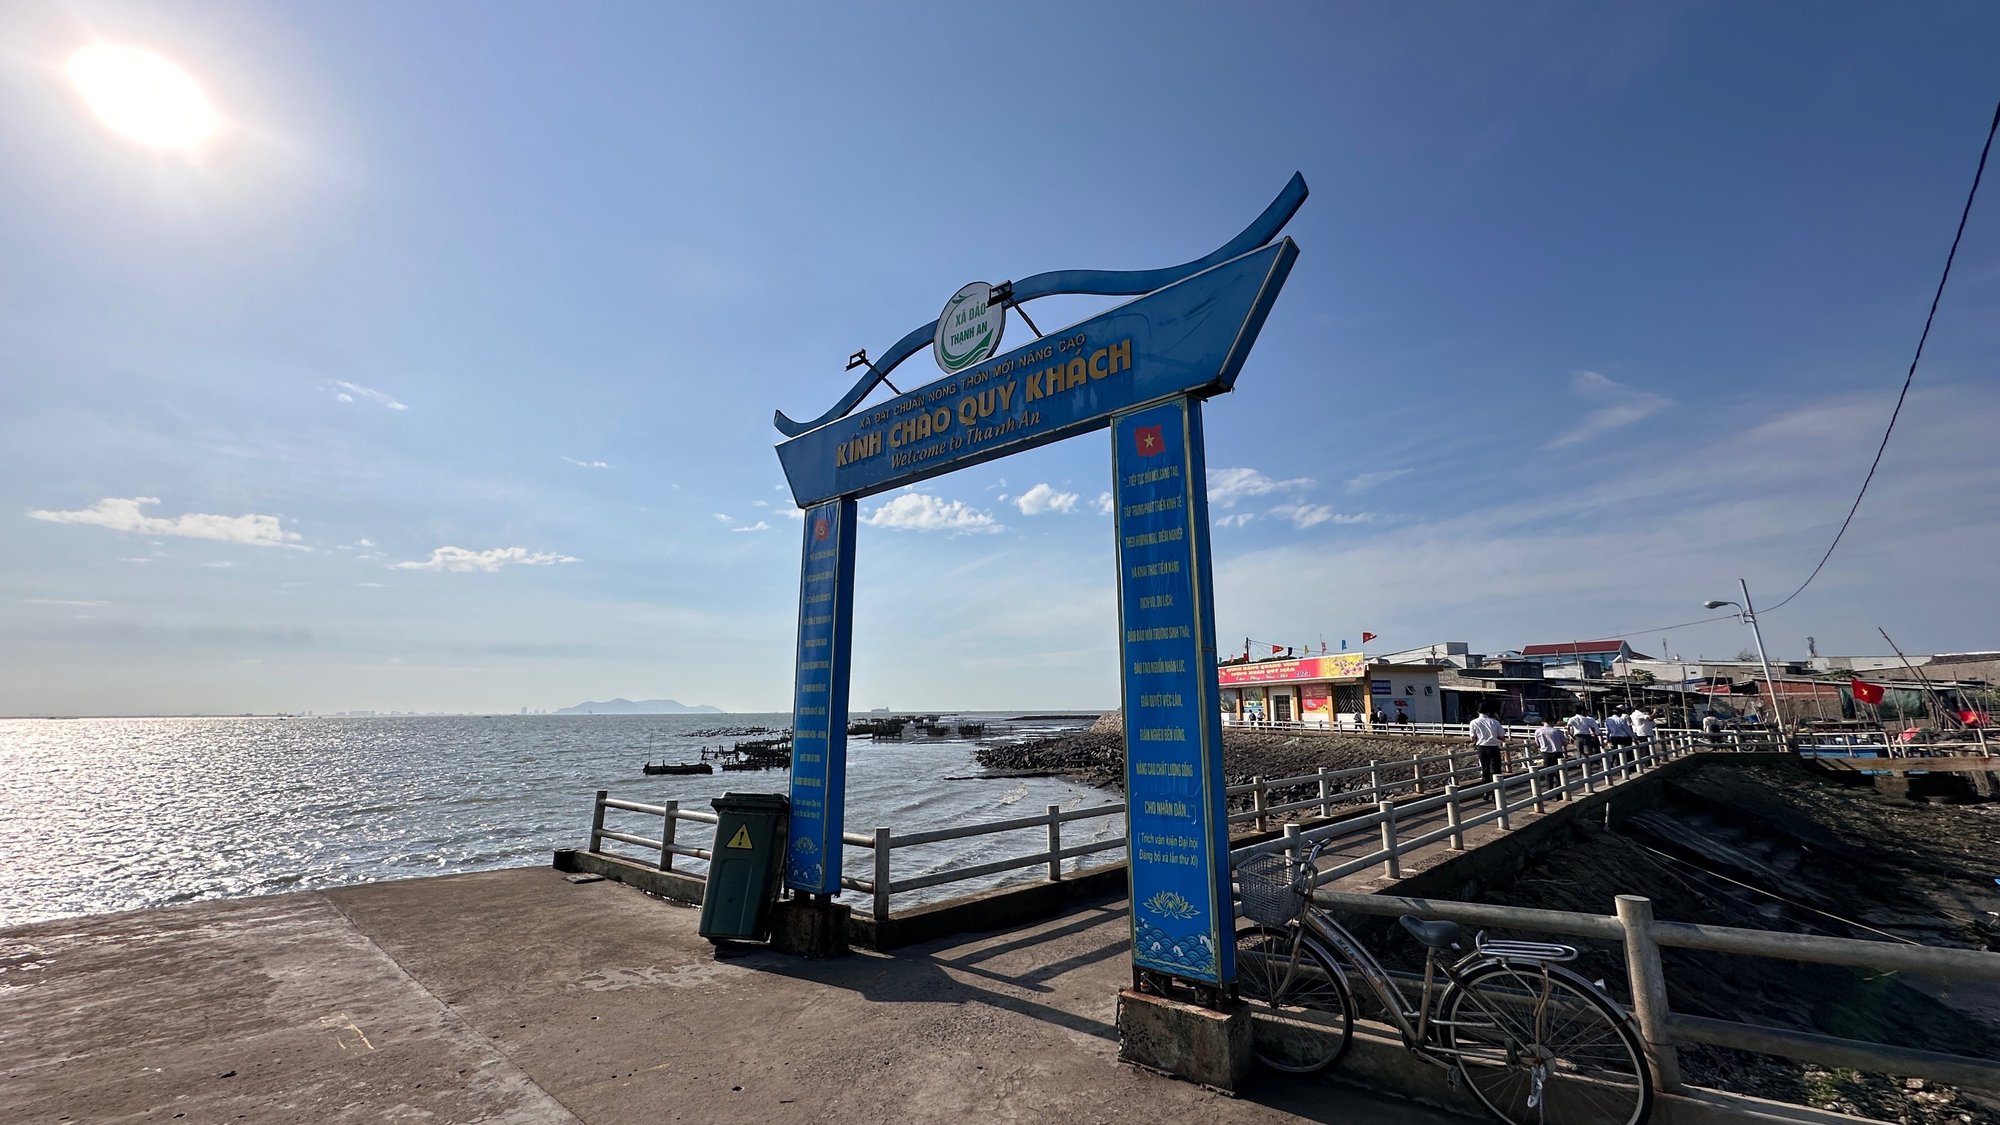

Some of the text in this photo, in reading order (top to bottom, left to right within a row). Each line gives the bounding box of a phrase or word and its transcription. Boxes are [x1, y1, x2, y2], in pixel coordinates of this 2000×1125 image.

[950, 321, 988, 347] THẠNH AN
[956, 301, 987, 327] XÃ ĐẢO
[928, 383, 957, 403] NÔNG
[961, 368, 989, 393] THÔN
[1058, 333, 1085, 354] CAO
[836, 338, 1131, 467] KÍNH CHÀO QUÝ KHÁCH
[891, 409, 1041, 469] Welcome to Thanh An
